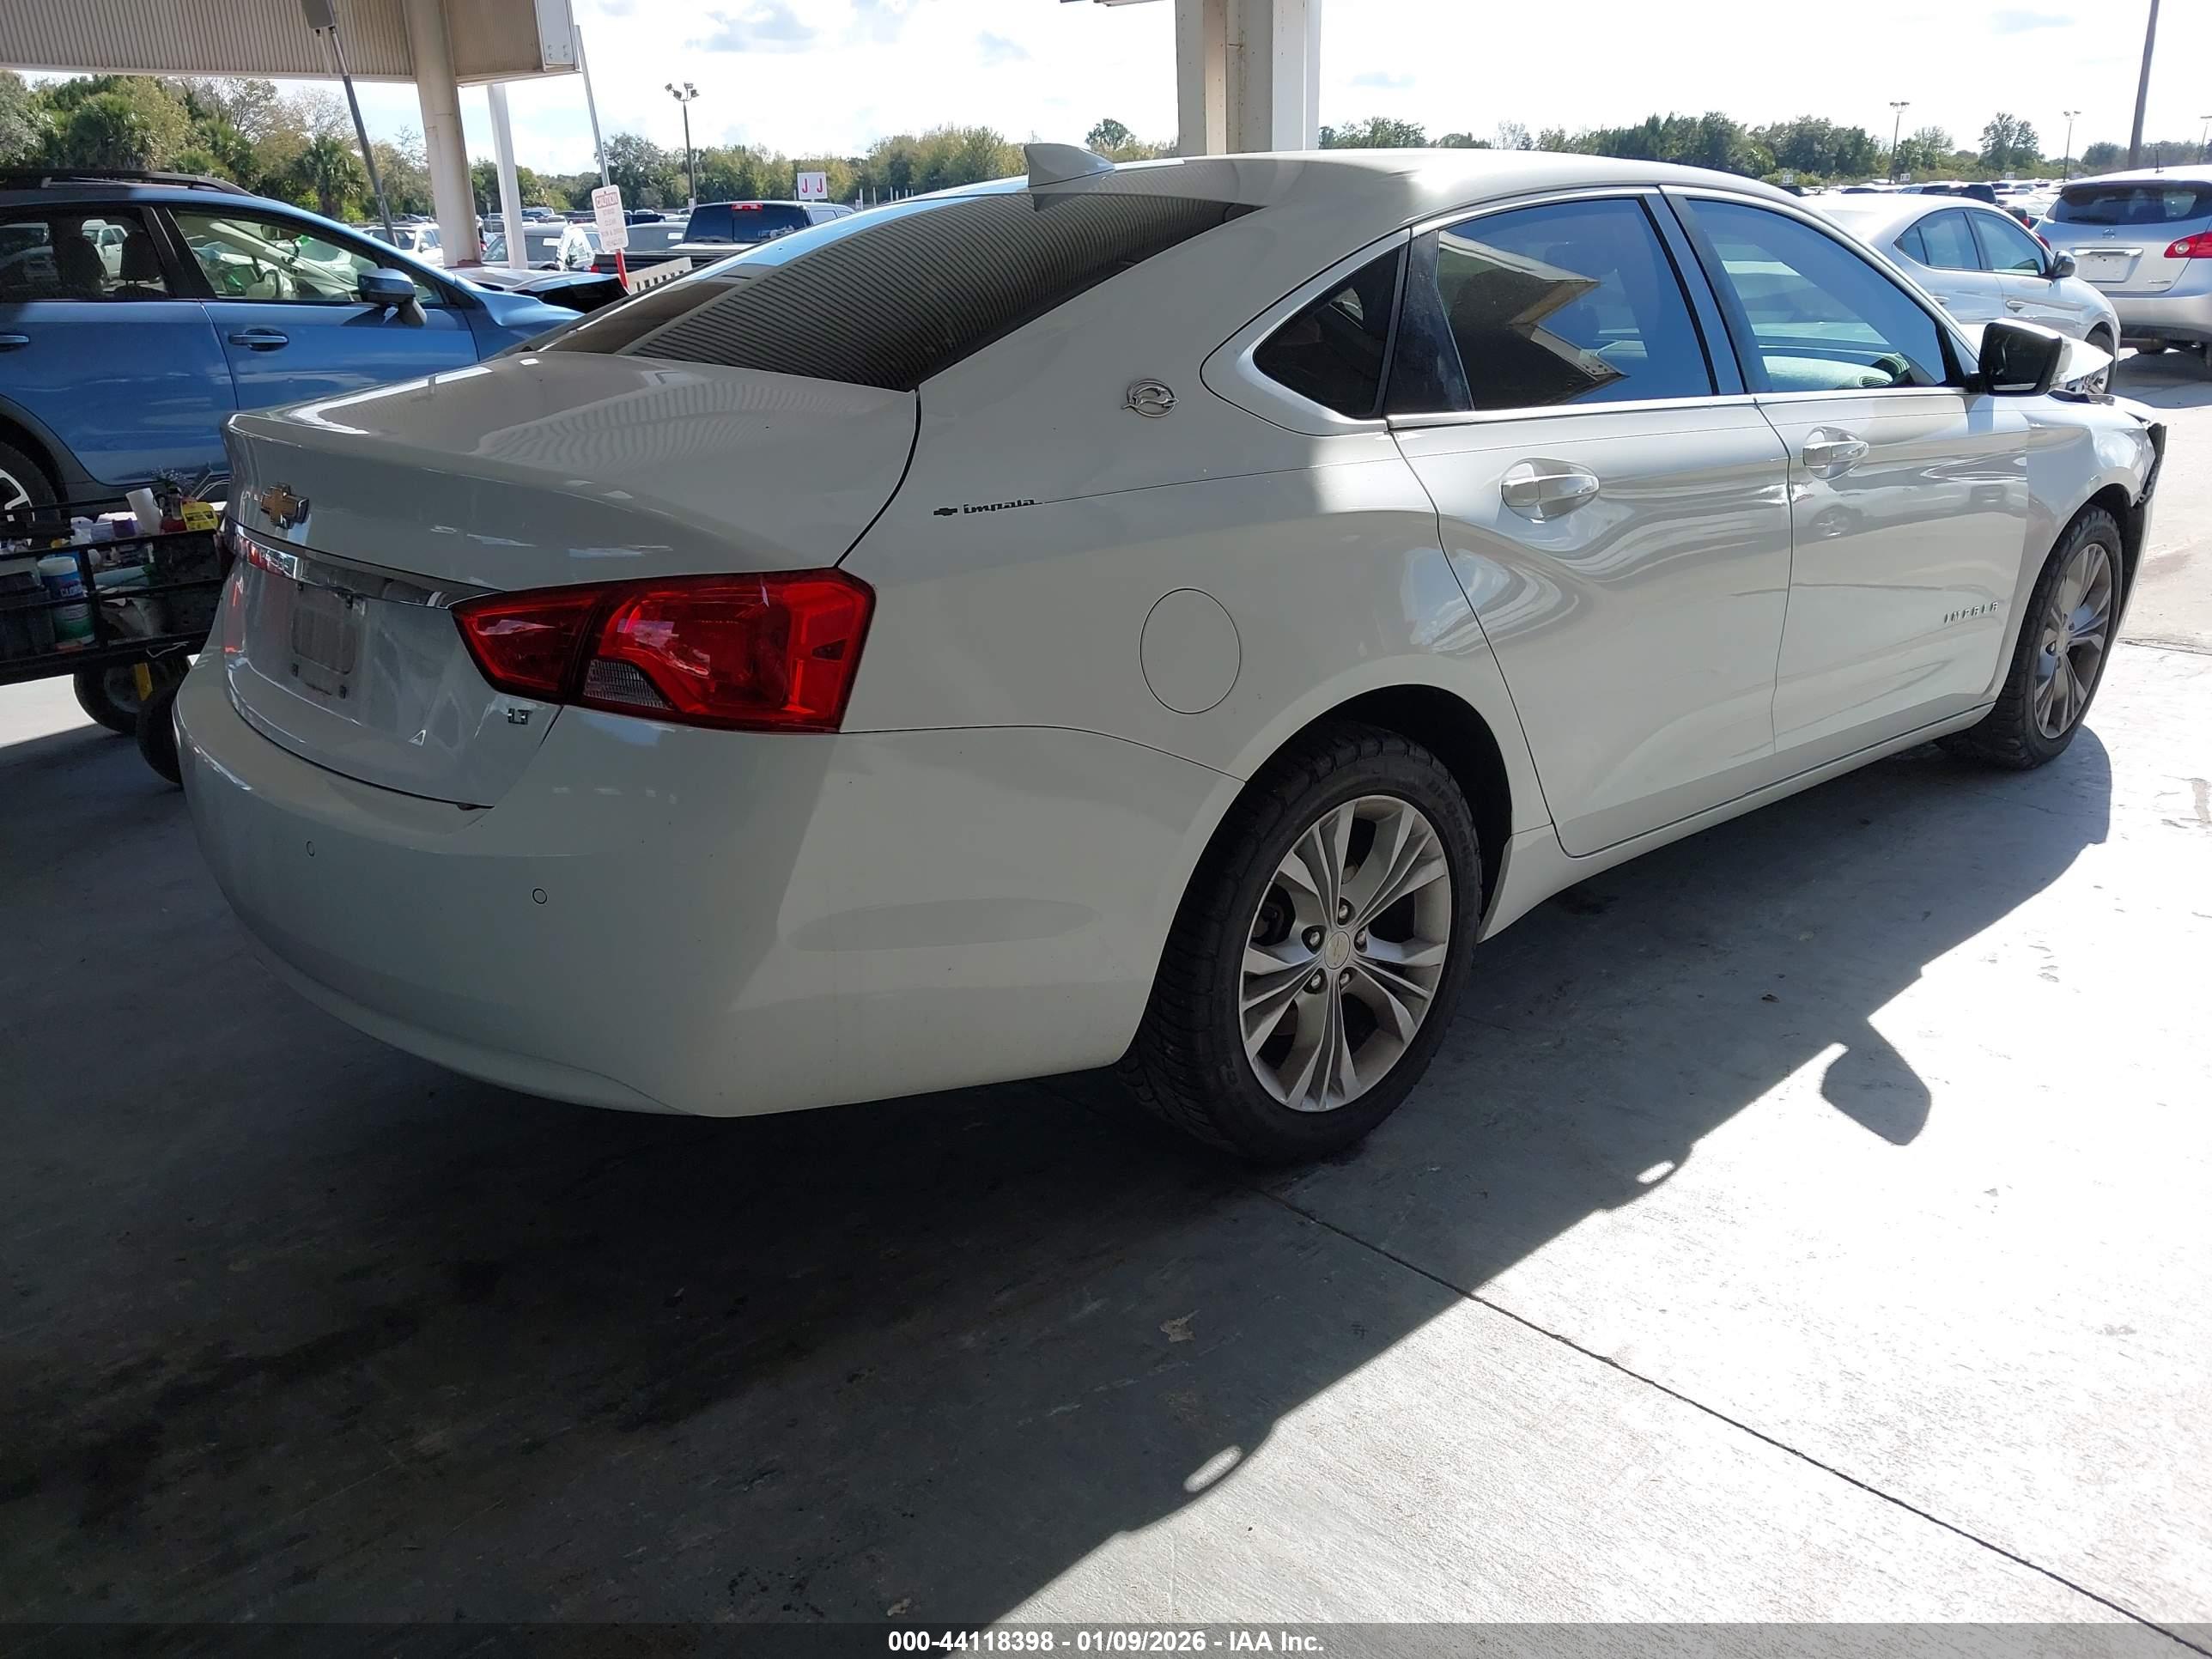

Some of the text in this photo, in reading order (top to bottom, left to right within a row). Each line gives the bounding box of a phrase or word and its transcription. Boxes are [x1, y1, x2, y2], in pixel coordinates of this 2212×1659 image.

[963, 499, 1041, 514] impala
[1944, 602, 1998, 625] IMPALA
[507, 708, 532, 725] LT
